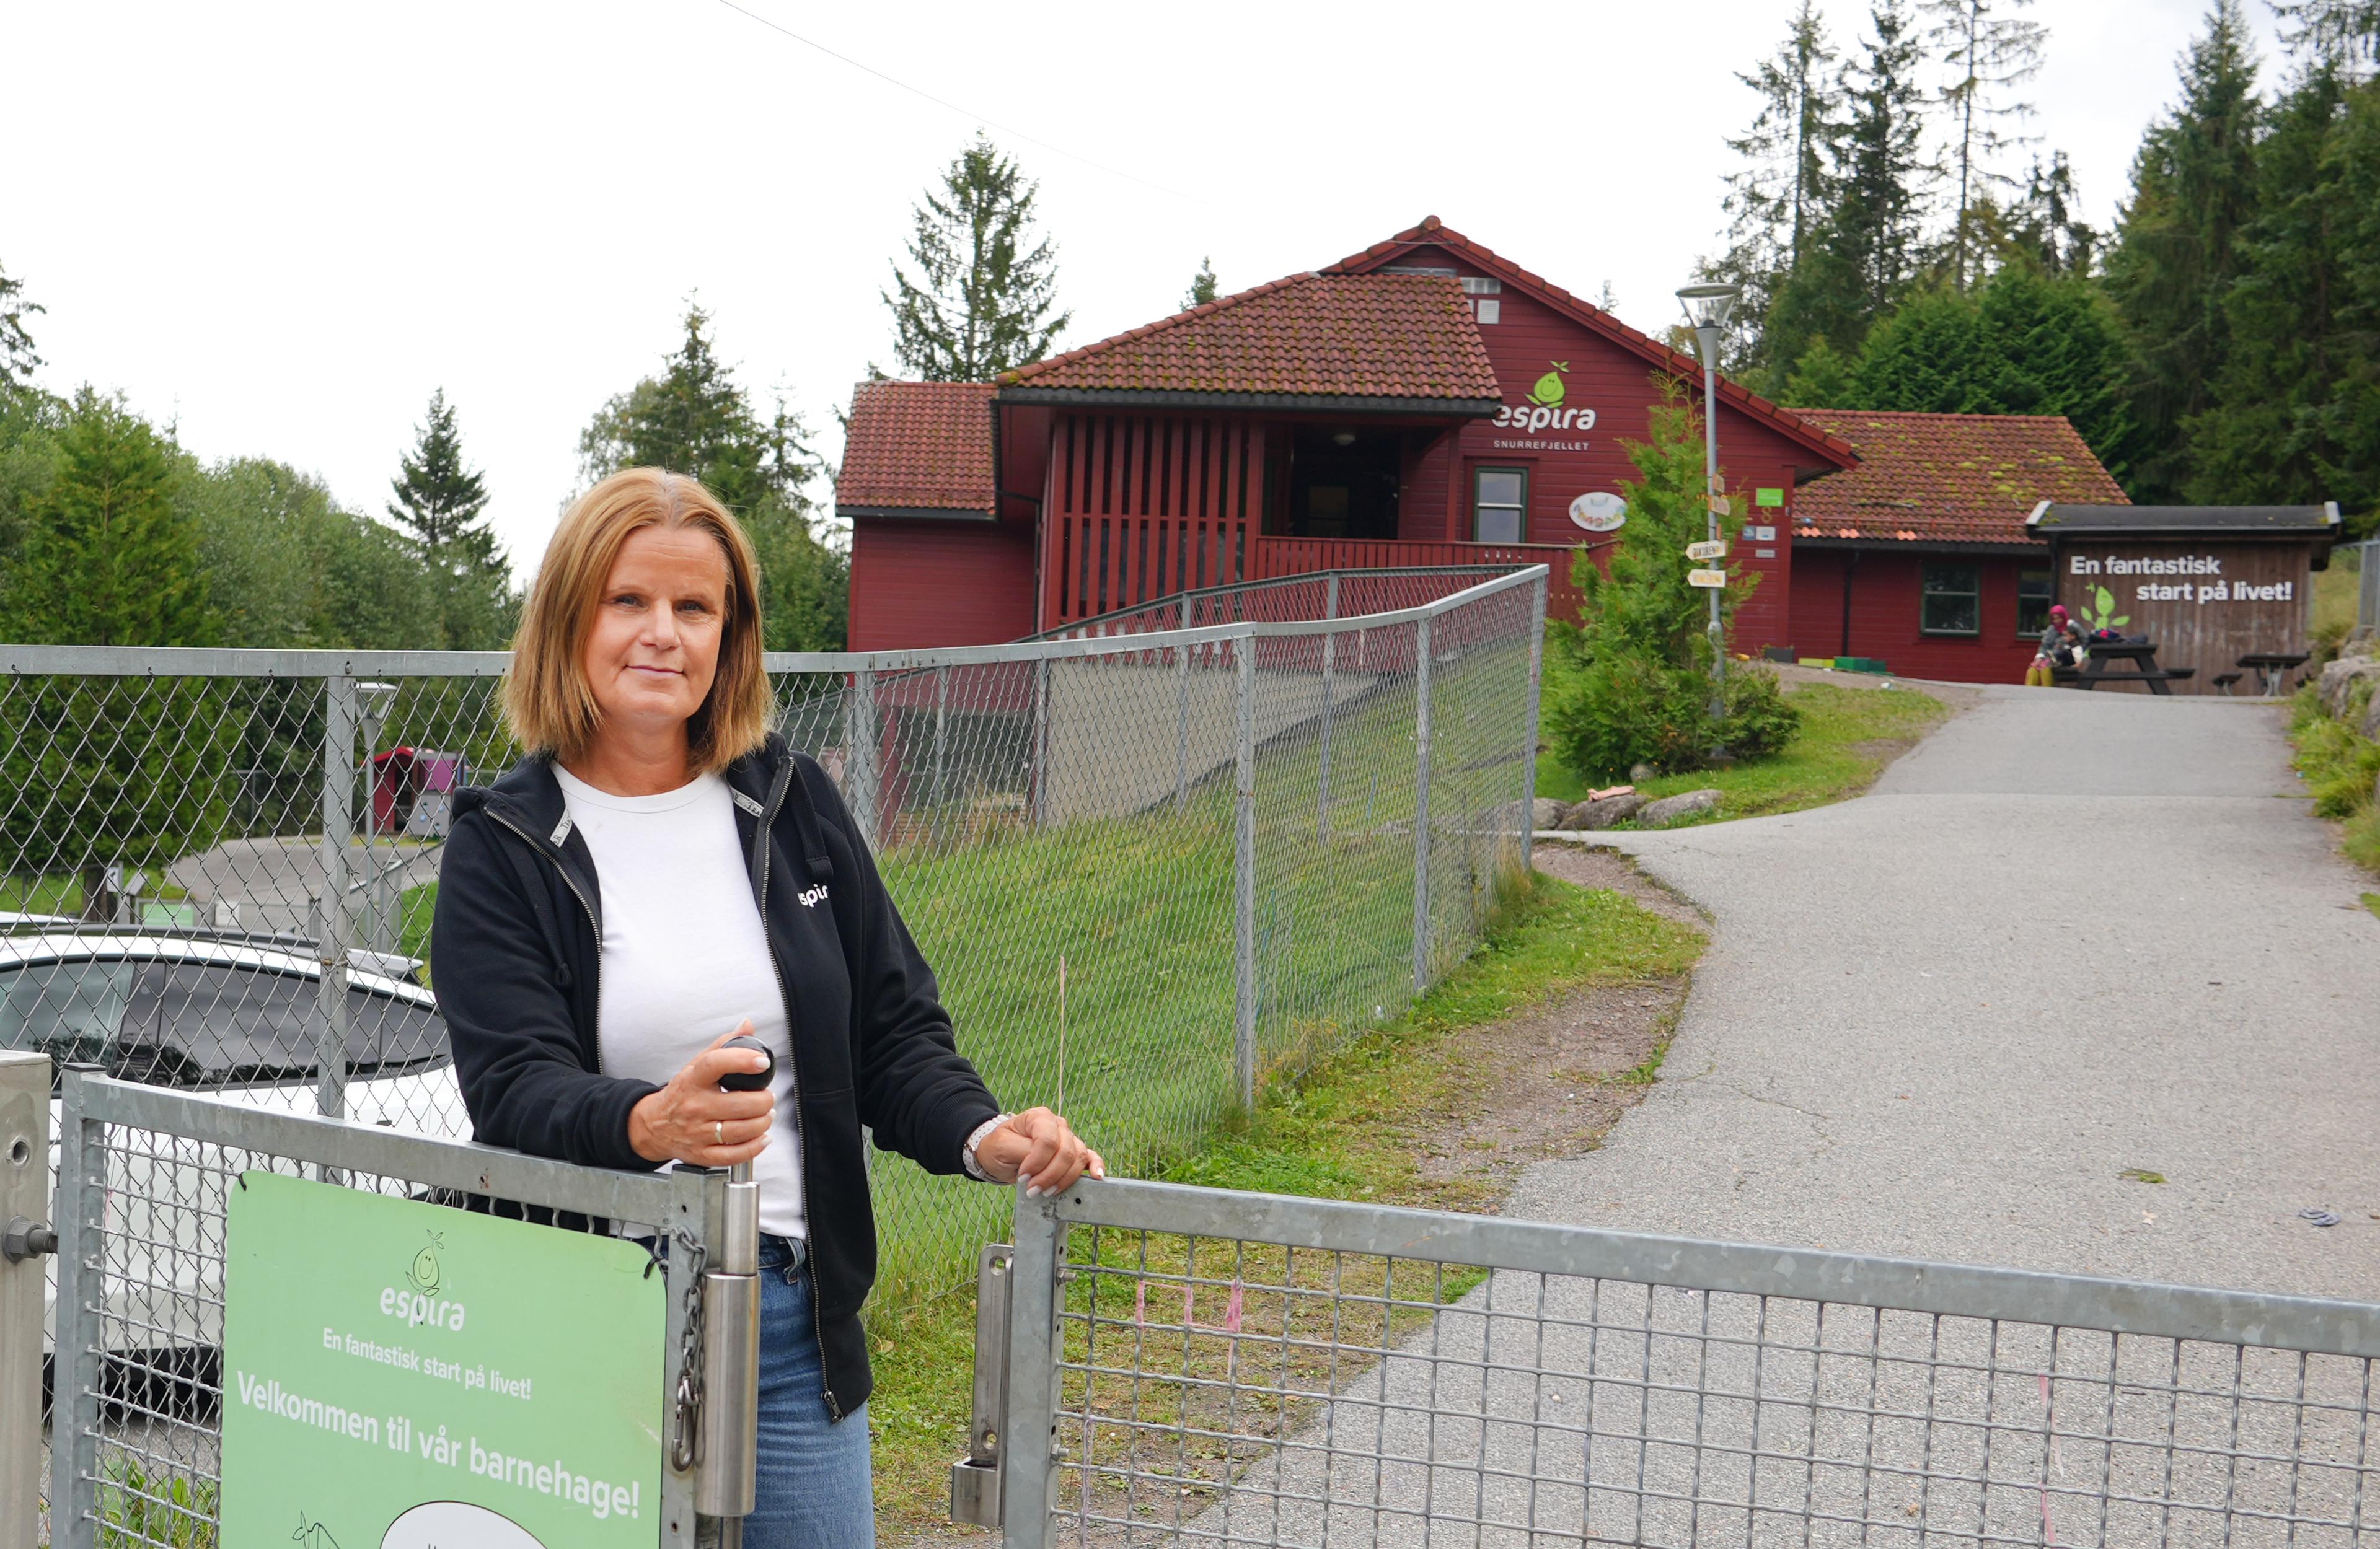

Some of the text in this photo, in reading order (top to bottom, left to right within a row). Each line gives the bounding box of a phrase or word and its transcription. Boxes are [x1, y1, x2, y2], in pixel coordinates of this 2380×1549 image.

[1492, 406, 1597, 434] espira
[1494, 440, 1589, 450] SNURREFJELLET
[1761, 506, 1773, 524] 8
[2071, 556, 2221, 574] En fantastisk
[2136, 579, 2292, 605] start på livet!
[797, 884, 828, 908] spir
[379, 1287, 465, 1332] espira
[323, 1327, 531, 1400] En fantastisk start på livet!
[237, 1370, 640, 1519] Velkommen til vår barnehage!
